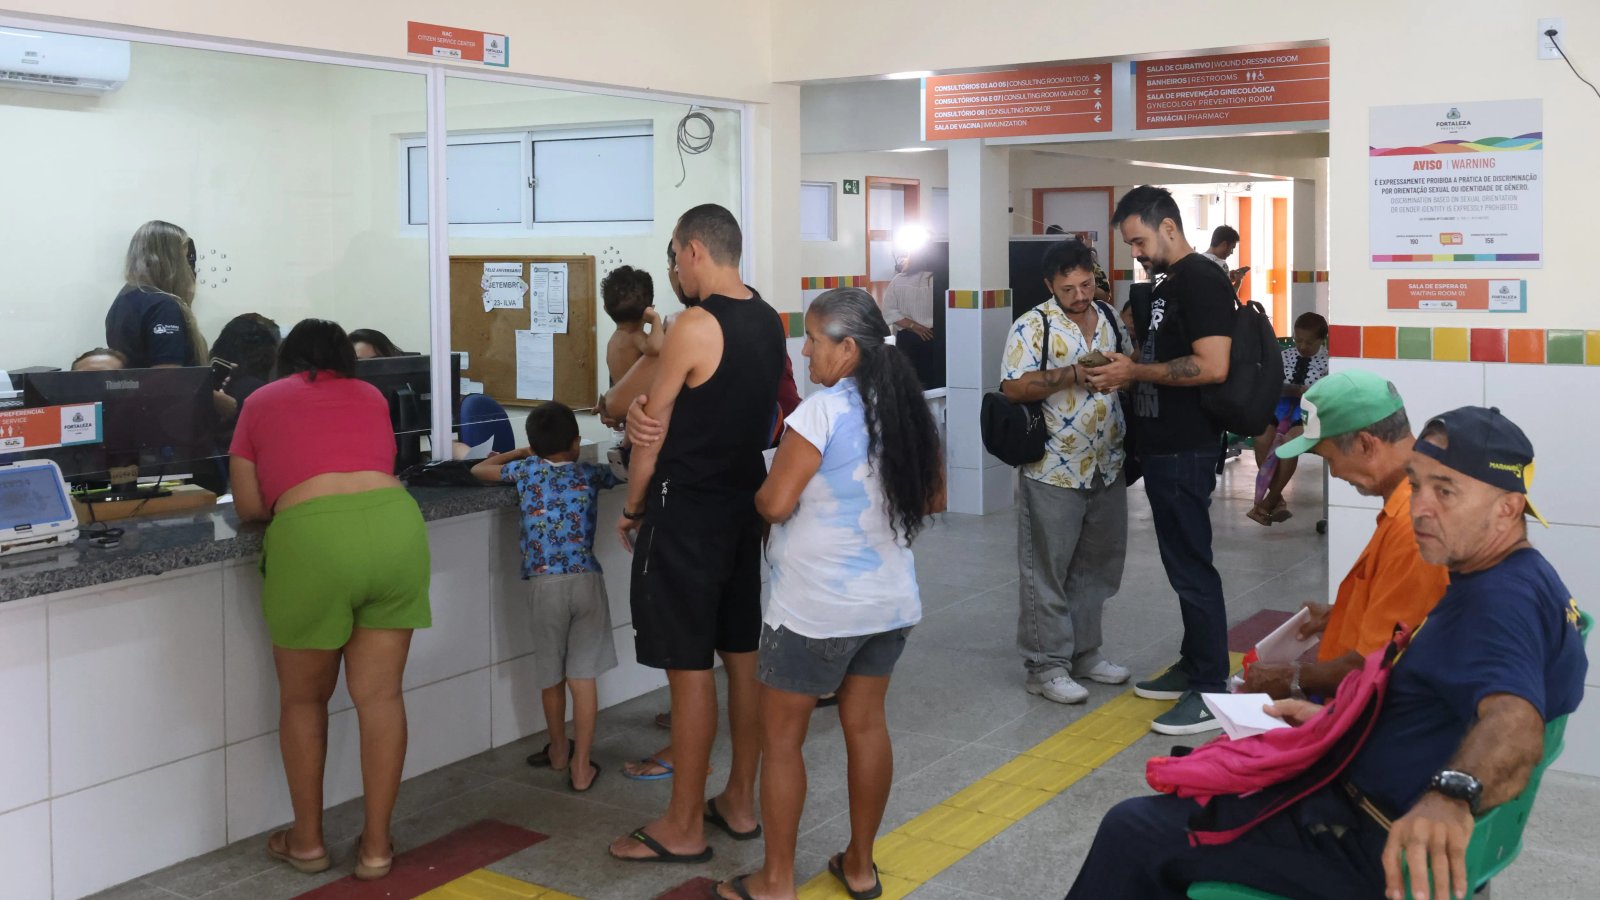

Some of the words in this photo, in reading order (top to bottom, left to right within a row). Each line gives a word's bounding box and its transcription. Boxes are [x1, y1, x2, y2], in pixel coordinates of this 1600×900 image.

[418, 35, 436, 43] CITIZEN
[437, 37, 456, 45] SERVICE
[457, 39, 475, 47] CENTER
[1175, 62, 1210, 70] CURATIVO
[1242, 57, 1275, 65] DRESSING
[1147, 78, 1186, 86] BANHEIROS
[1192, 74, 1238, 83] RESTROOMS
[934, 83, 979, 92] CONSULTÓRIOS
[1176, 88, 1219, 98] PREVENÇÃO
[1220, 85, 1275, 95] GINECOLÓGICA
[934, 96, 979, 105] CONSULTÓRIOS
[1147, 101, 1196, 109] GYNECOLOGY
[1199, 97, 1246, 106] PREVENTION
[934, 110, 976, 118] CONSULTÓRIO
[988, 107, 1023, 115] CONSULTING
[1147, 114, 1183, 123] FARMÁCIA
[1188, 112, 1230, 120] PHARMACY
[984, 120, 1027, 128] IMMUNIZATION
[1413, 160, 1442, 170] AVISO
[1452, 158, 1496, 169] WARNING
[1493, 173, 1537, 182] DISCRIMINAÇÃO
[1382, 187, 1392, 195] POR
[1394, 186, 1427, 194] ORIENTAÇÃO
[1453, 204, 1483, 212] EXPRESSLY
